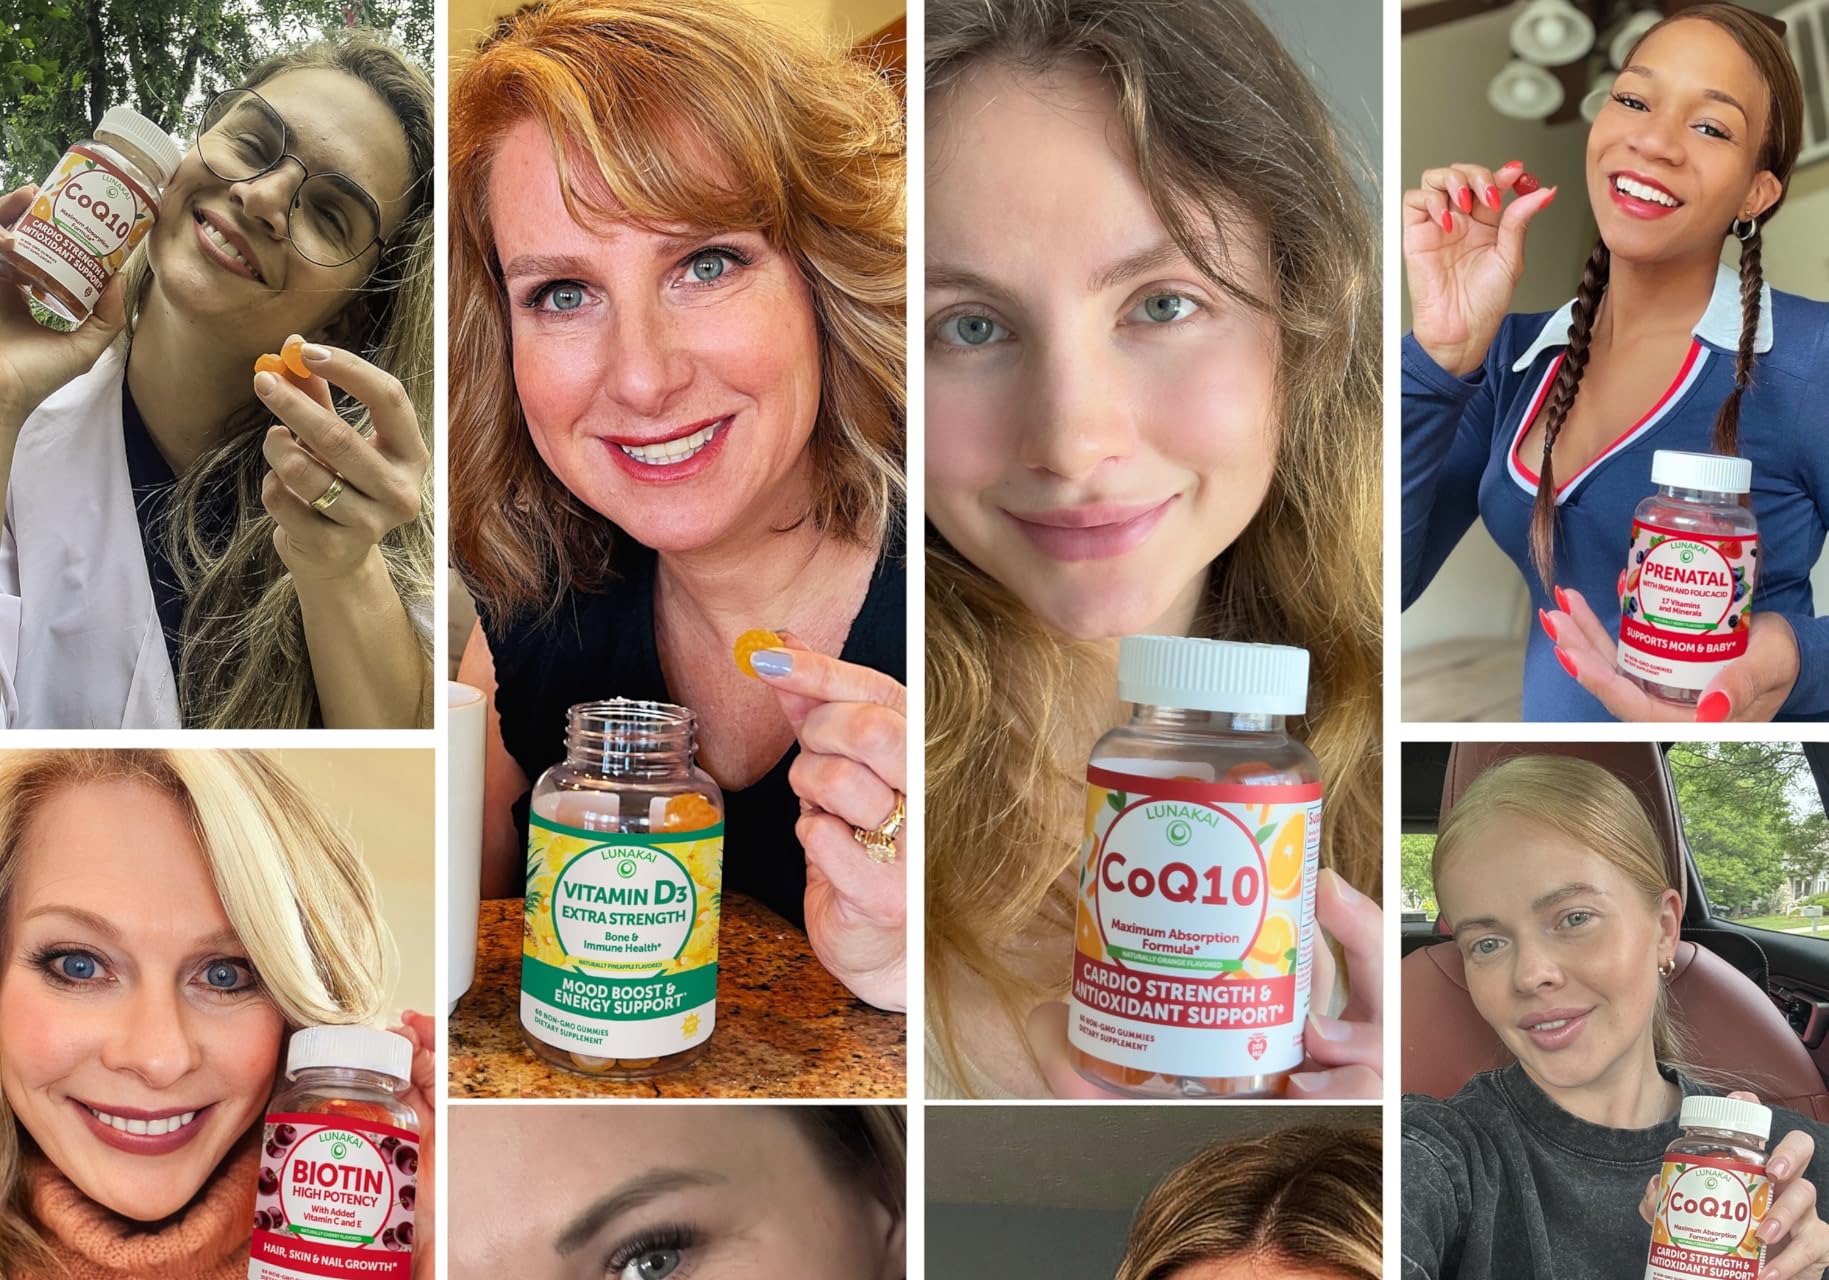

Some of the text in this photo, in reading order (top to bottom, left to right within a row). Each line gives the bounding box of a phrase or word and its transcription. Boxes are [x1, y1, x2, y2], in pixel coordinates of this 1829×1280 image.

[102, 174, 131, 201] LUNAKAI
[64, 182, 129, 240] CoQ10
[60, 208, 84, 228] Maximum
[84, 226, 110, 249] Absorption
[21, 225, 75, 263] ANTIOXIDANT
[32, 220, 63, 241] CARDIO
[63, 239, 103, 275] STRENGTH
[1670, 541, 1708, 554] LUNAKAI
[1644, 561, 1729, 587] PRENATAL
[1643, 580, 1657, 589] WITH
[1658, 583, 1674, 592] IRON
[1674, 587, 1689, 595] AND
[1671, 599, 1700, 609] Vitamins
[1672, 608, 1702, 616] Minerals
[1627, 627, 1668, 648] SUPPORTS
[1669, 641, 1695, 653] MOM
[1697, 644, 1704, 653] &
[1145, 804, 1220, 829] LUNAKAI
[601, 848, 657, 864] LUNAKAI
[1101, 852, 1259, 907] CoQ10
[563, 879, 688, 906] VITAMIN D3
[562, 907, 687, 926] EXTRA STRENGTH
[605, 932, 639, 942] Bone &
[1112, 918, 1239, 945] Maximum Absorption
[584, 940, 623, 953] Immune
[578, 959, 607, 969] NATURALLY
[1122, 950, 1223, 969] NATURALLY ORANGE FLAVORED
[562, 977, 676, 999] MOOD BOOST &
[1083, 963, 1271, 1003] CARDIO STRENGTH &
[554, 988, 610, 1013] ENERGY
[1074, 980, 1184, 1022] ANTIOXIDANT
[534, 1016, 603, 1045] DIETARY SUPPLEMENT
[535, 1008, 609, 1037] 60 NON-GMO GUMMIES
[1085, 1016, 1155, 1042] NON-GMO GUMMIES
[1079, 1024, 1148, 1052] DIETARY SUPPLEMENT
[319, 1132, 364, 1149] LUNAKAI
[292, 1159, 384, 1195] BIOTIN
[1695, 1169, 1732, 1182] LUNAKAI
[292, 1185, 378, 1208] HIGH POTENCY
[1670, 1192, 1748, 1222] CoQ10
[304, 1212, 332, 1224] Vitamin
[340, 1219, 355, 1227] and
[357, 1220, 363, 1228] E
[311, 1205, 355, 1218] With Added
[1674, 1224, 1737, 1239] Maximum Absorption
[263, 1242, 287, 1258] HAIR,
[289, 1249, 311, 1262] SKIN
[312, 1254, 320, 1263] &
[321, 1256, 344, 1268] NAIL
[1651, 1256, 1709, 1275] ANTIOXIDANT
[1657, 1246, 1749, 1270] CARDIO STRENGTH &
